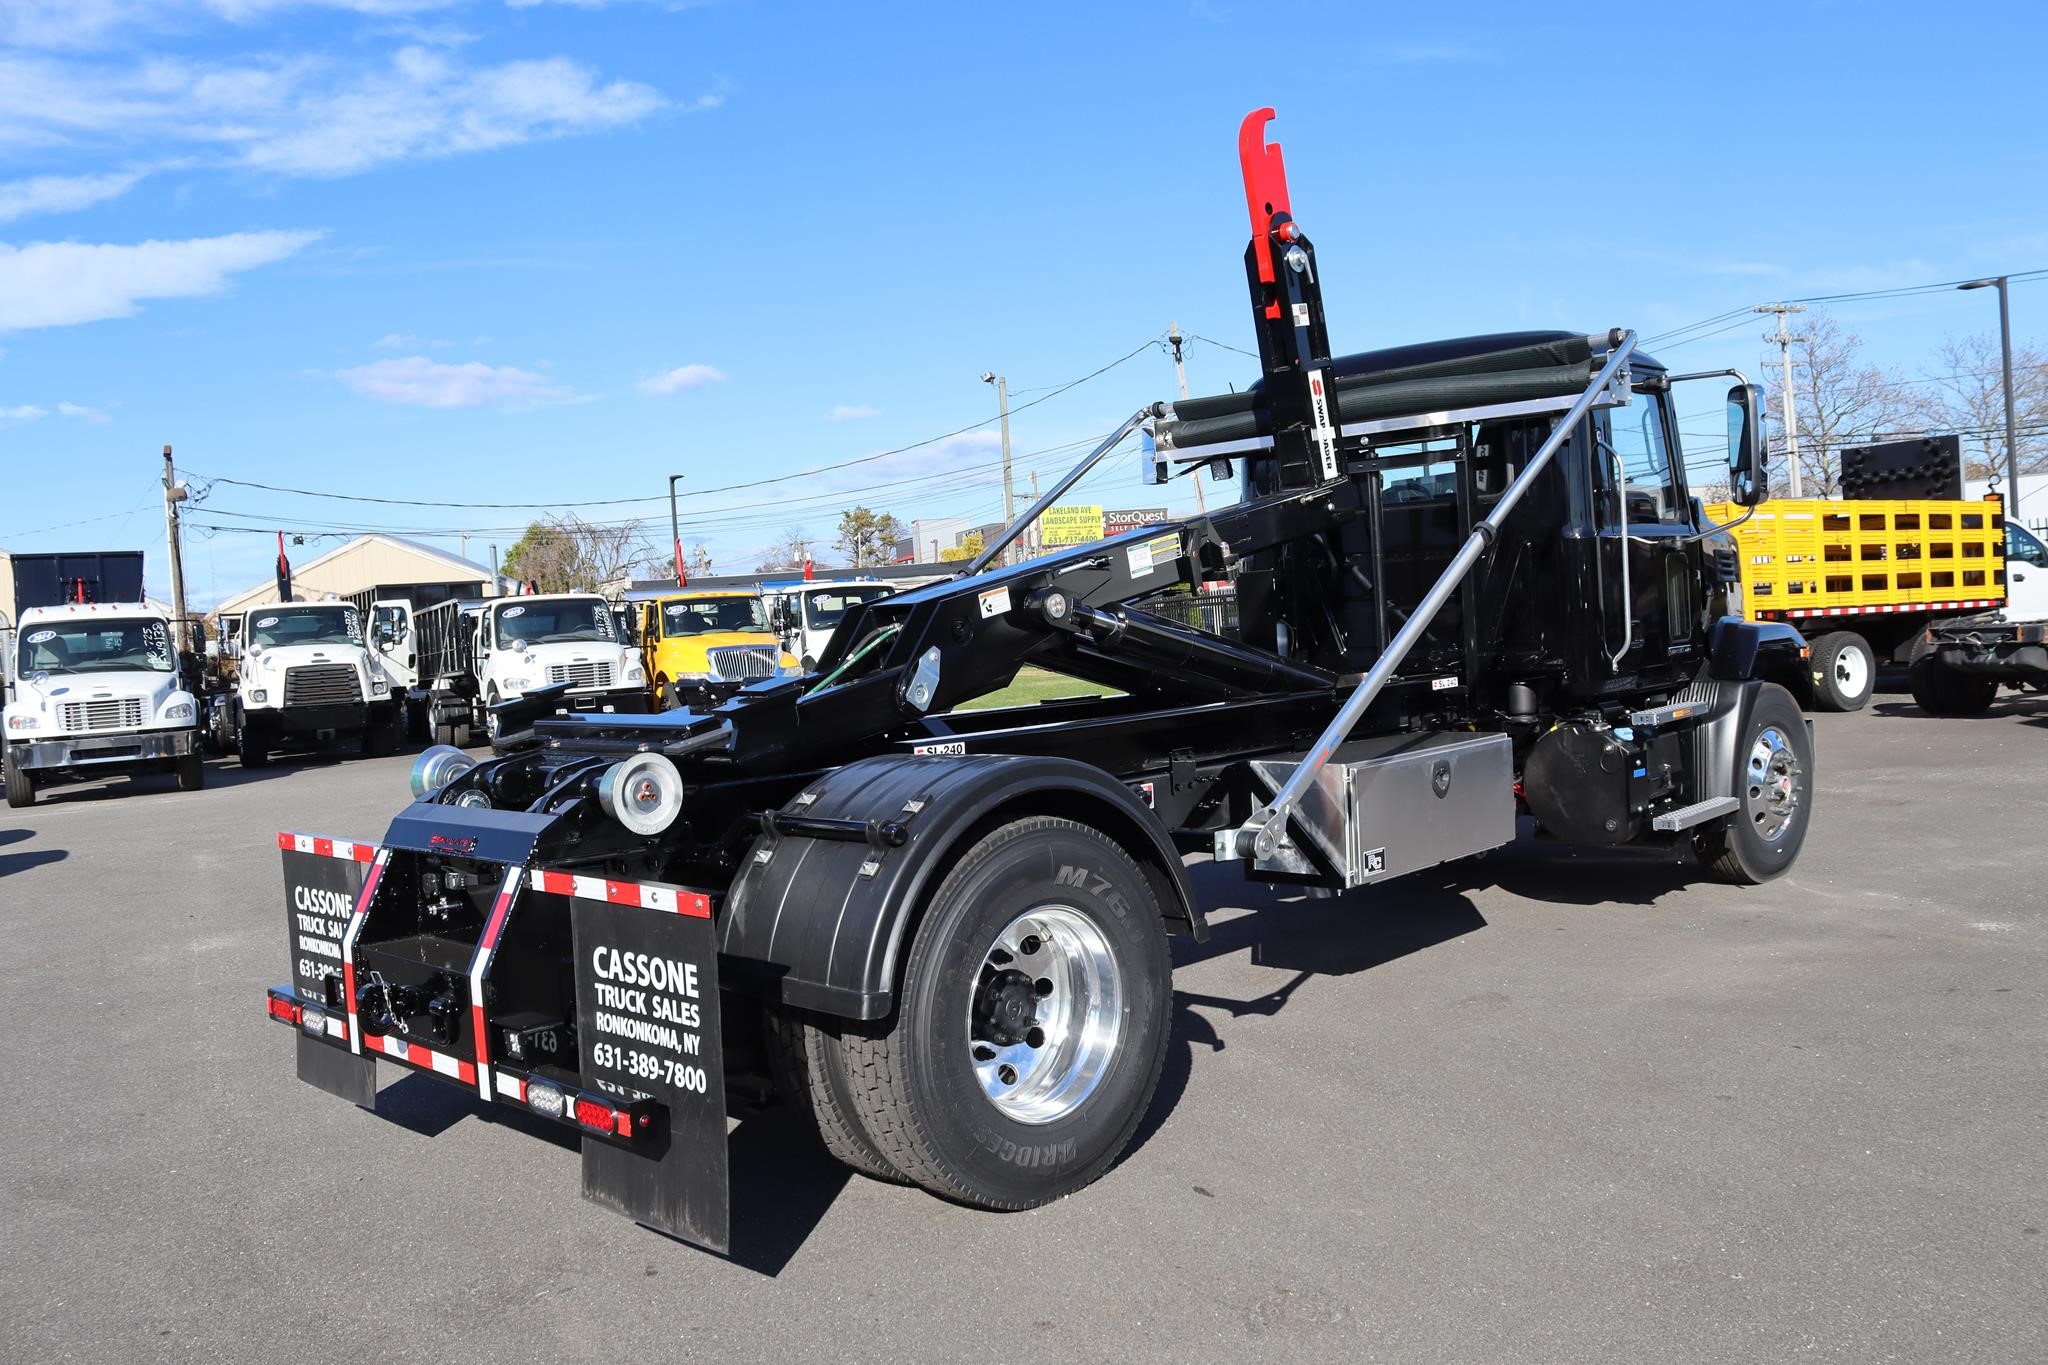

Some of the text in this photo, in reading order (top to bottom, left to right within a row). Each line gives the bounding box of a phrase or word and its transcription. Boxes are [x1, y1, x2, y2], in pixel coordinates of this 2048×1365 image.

[1043, 515, 1102, 525] LANDSCAPE SUPPLY
[1049, 505, 1092, 515] LAKELAND AVE
[1109, 510, 1166, 525] StorQuest
[294, 885, 353, 920] CASSONE
[297, 914, 326, 936] TRUCK
[299, 934, 342, 960] RONKONKOM
[592, 945, 700, 999] CASSONE
[594, 982, 701, 1028] TRUCK SALES
[596, 1011, 701, 1056] RONKONKOMA, NY
[593, 1042, 707, 1094] 631-389-7800
